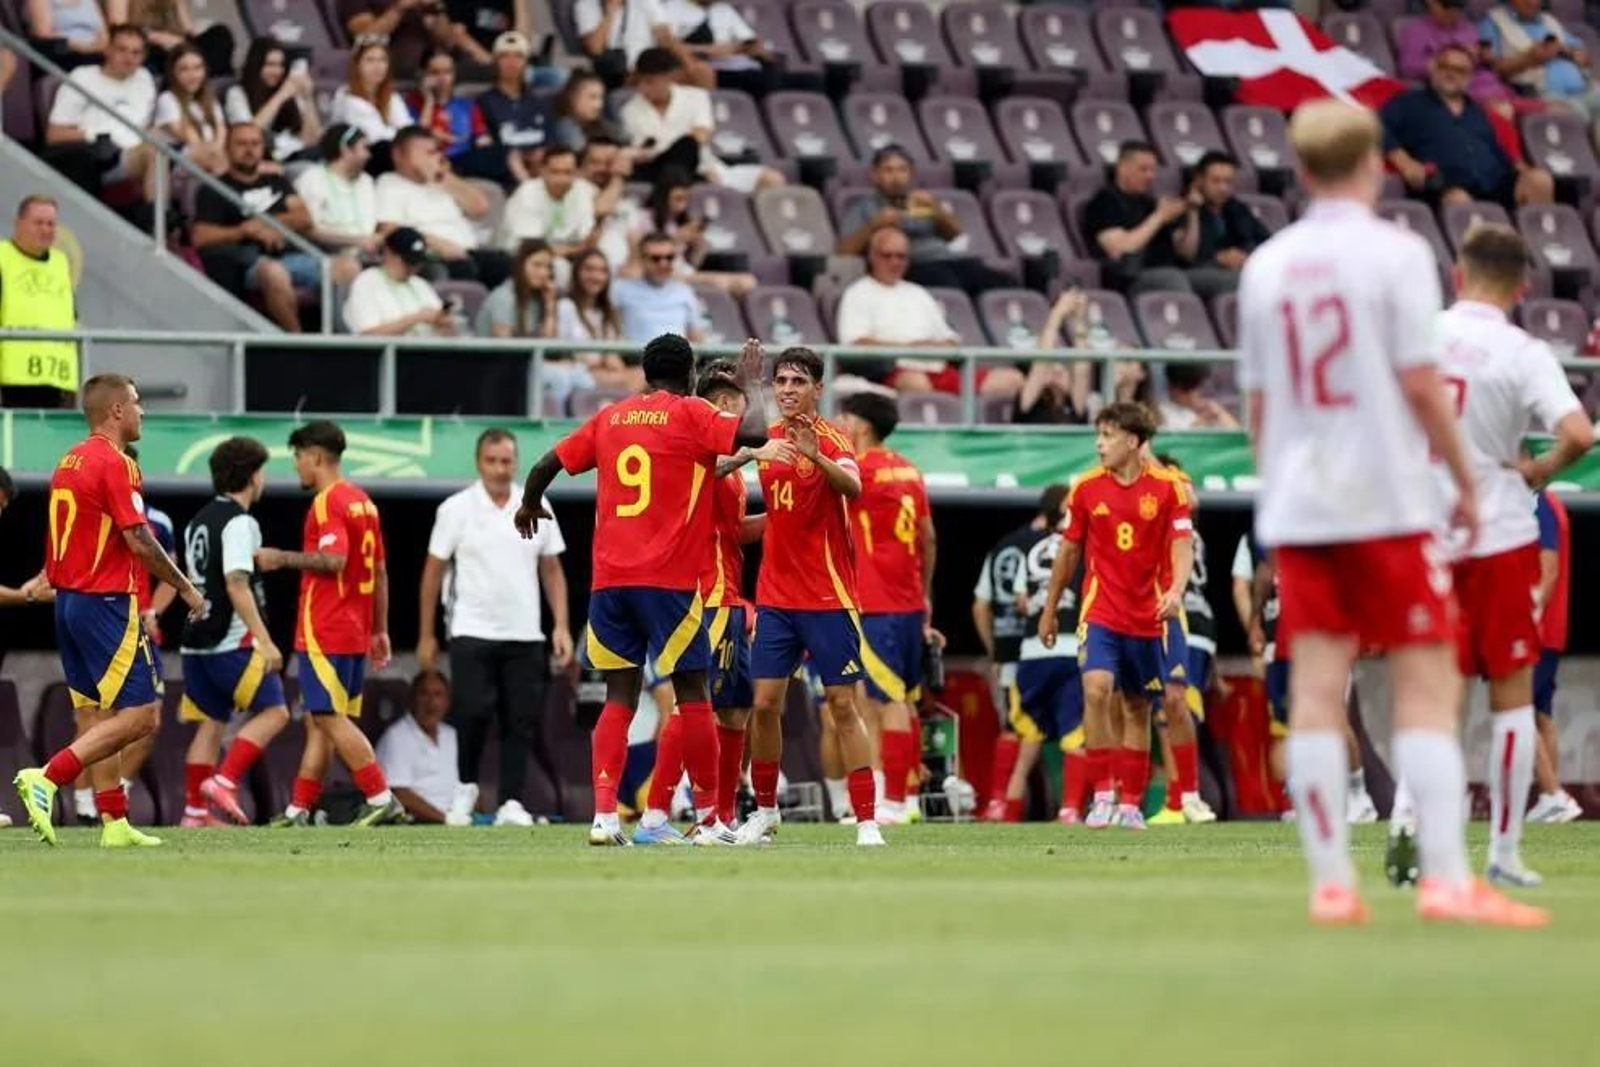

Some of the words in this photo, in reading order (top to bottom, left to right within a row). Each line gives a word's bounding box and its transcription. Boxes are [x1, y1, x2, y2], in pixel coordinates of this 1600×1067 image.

[1281, 292, 1357, 407] 12
[616, 444, 651, 517] 9
[770, 478, 794, 511] 14
[1117, 522, 1134, 550] 8
[359, 530, 375, 594] 3
[719, 638, 734, 670] 10
